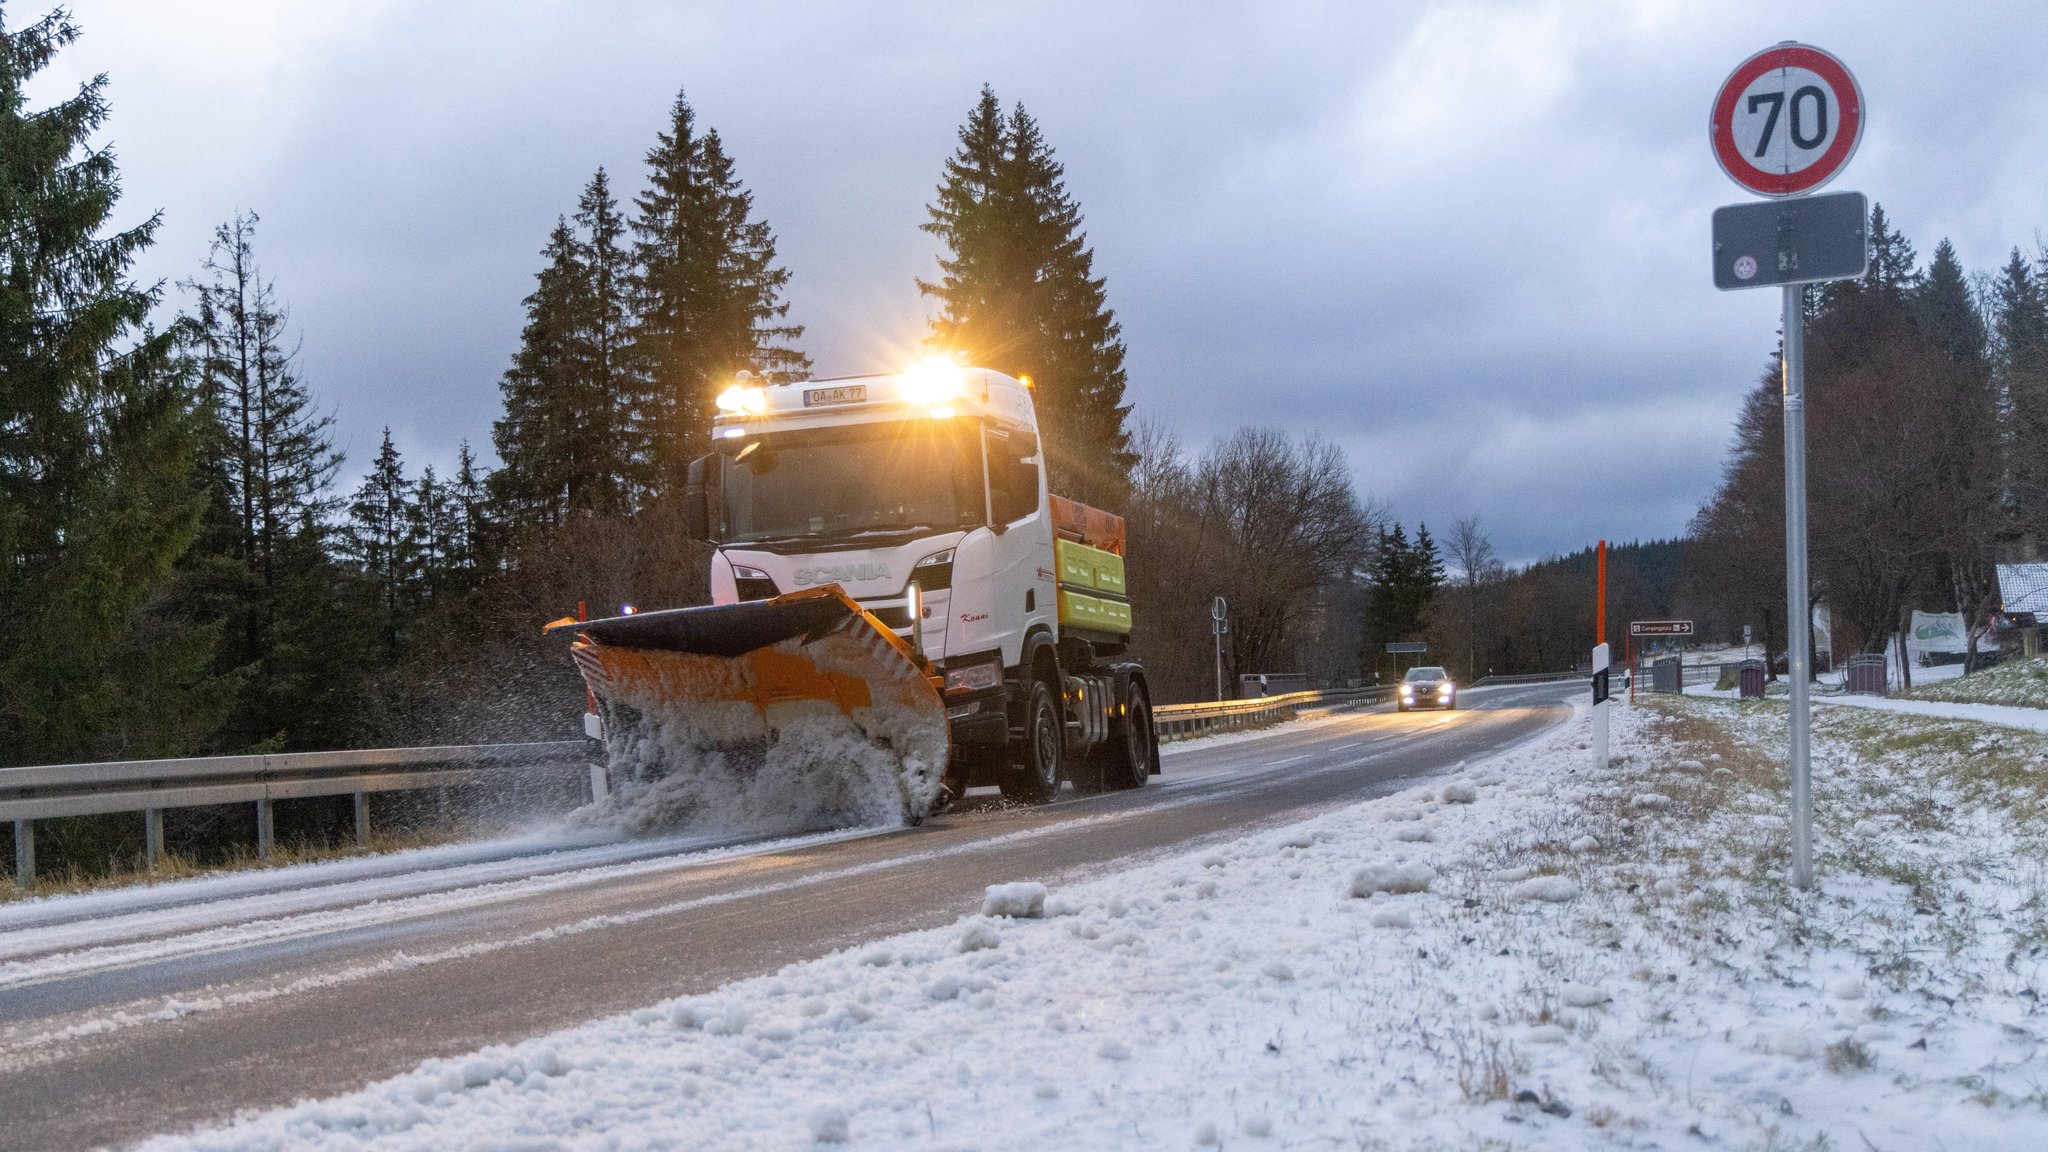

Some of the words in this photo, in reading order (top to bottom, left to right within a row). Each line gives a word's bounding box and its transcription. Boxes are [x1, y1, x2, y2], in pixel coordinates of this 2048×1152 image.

[1748, 85, 1827, 158] 70
[813, 391, 826, 402] OA
[833, 389, 845, 400] AK
[849, 387, 862, 398] 77
[793, 563, 892, 586] SCANIA
[961, 612, 989, 623] Konni
